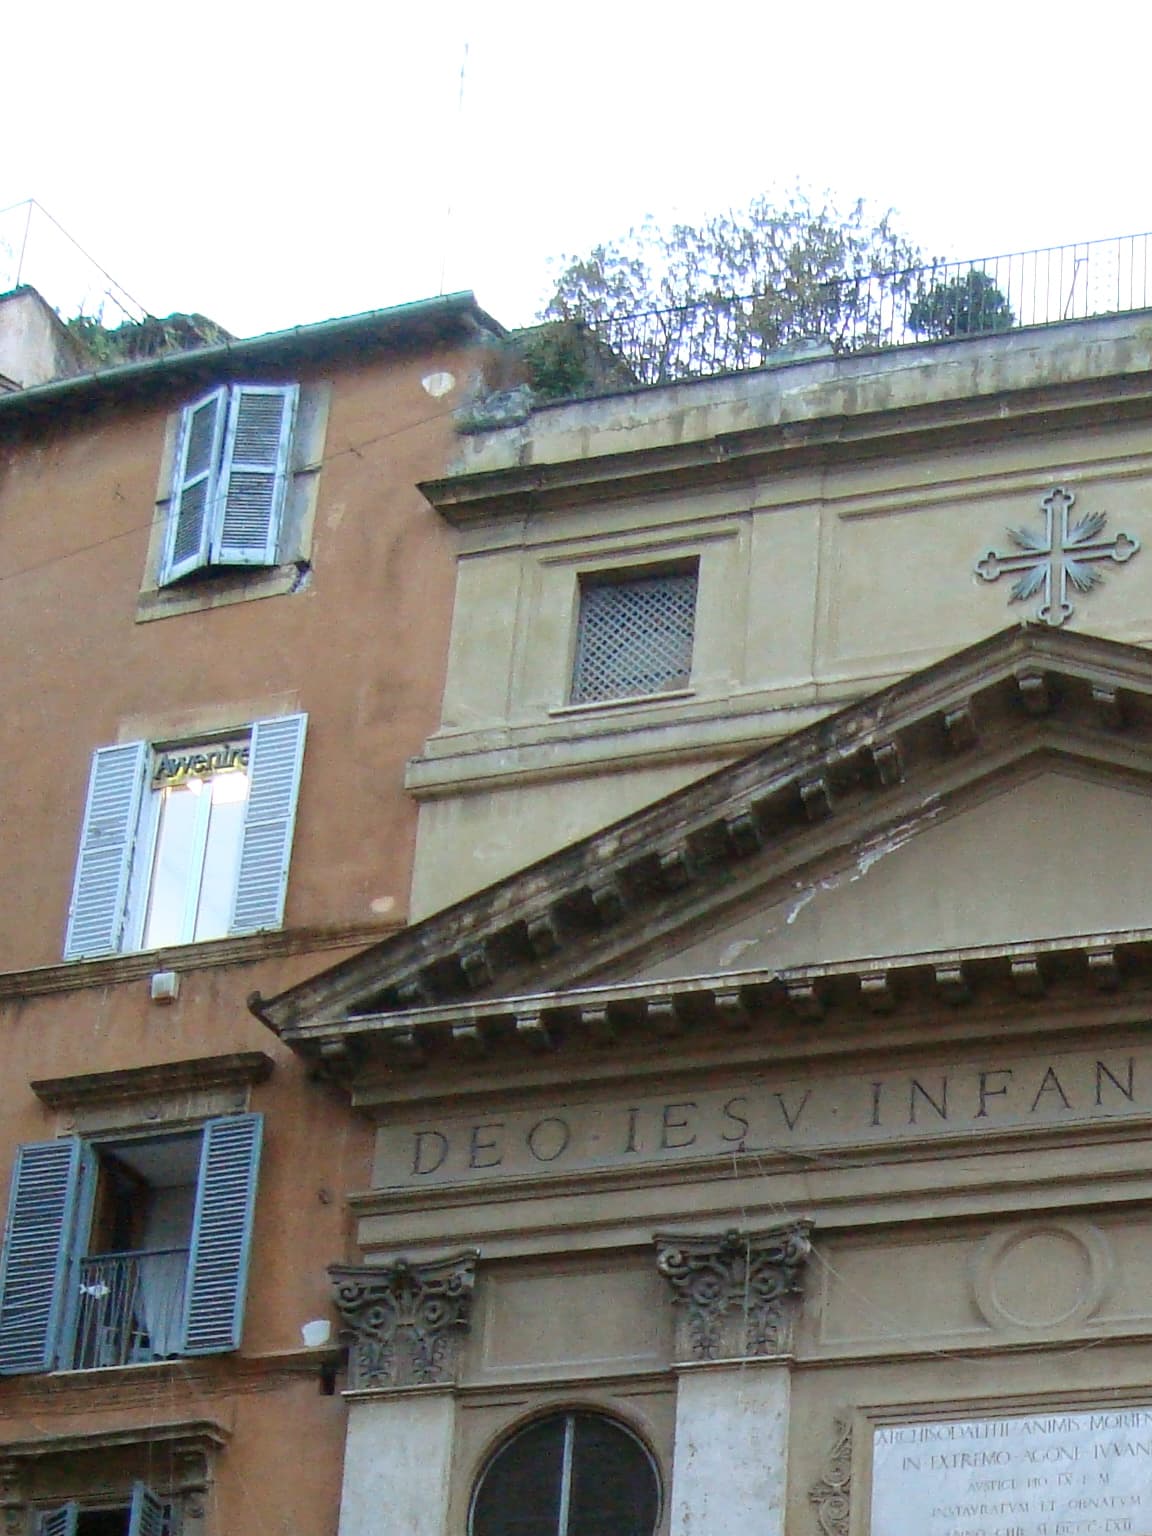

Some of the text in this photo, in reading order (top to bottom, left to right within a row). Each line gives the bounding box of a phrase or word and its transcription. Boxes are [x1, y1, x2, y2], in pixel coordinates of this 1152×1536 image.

[411, 1117, 571, 1175] DEO
[624, 1090, 811, 1153] IESV
[1021, 1417, 1081, 1435] ANIMIS
[902, 1457, 921, 1471] IN
[931, 1451, 1011, 1469] EXTREMO
